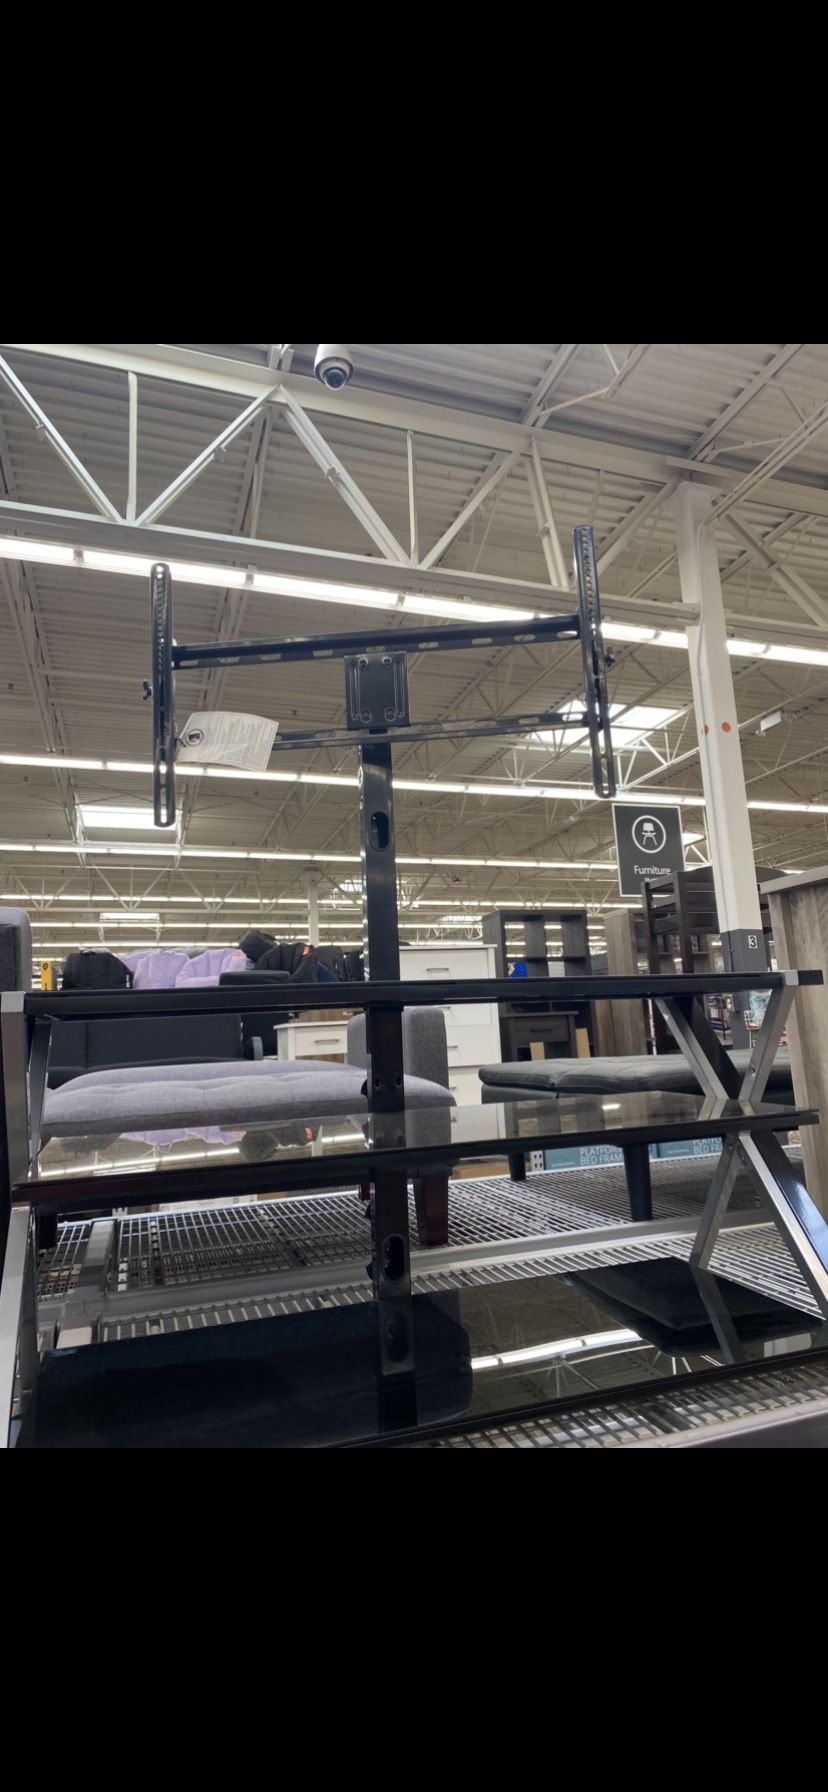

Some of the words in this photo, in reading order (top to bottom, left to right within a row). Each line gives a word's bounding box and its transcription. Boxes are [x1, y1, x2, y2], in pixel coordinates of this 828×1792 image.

[633, 865, 672, 875] Furniture
[750, 936, 757, 948] 3
[693, 1144, 709, 1154] BED
[580, 1155, 597, 1166] BED
